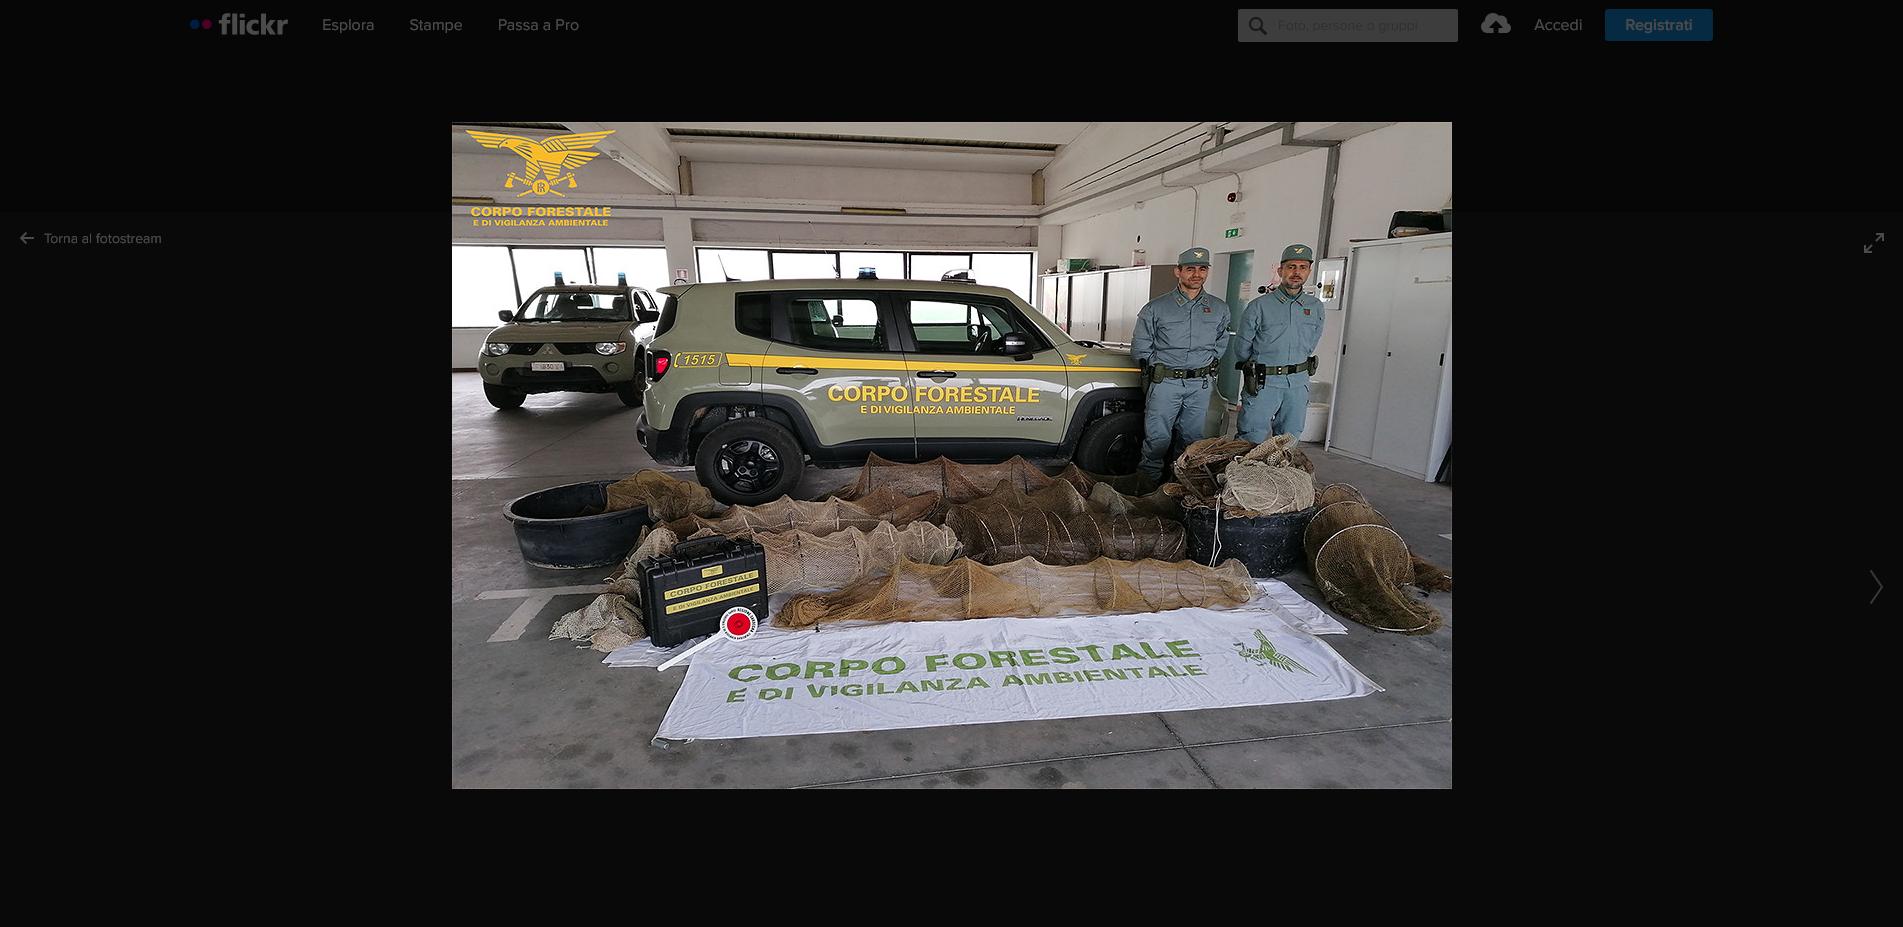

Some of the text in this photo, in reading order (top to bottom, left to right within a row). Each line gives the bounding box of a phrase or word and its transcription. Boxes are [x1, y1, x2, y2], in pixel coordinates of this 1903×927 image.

[219, 12, 288, 36] flickr
[322, 18, 374, 34] Esplora
[409, 18, 463, 34] Stampe
[498, 18, 579, 31] Passa a Pro
[1534, 18, 1582, 31] Accedi
[1626, 18, 1693, 34] Registrati
[44, 232, 162, 244] Torna al fotostream
[684, 354, 715, 365] 1515
[828, 385, 1040, 403] CORPO FORESTALE
[860, 405, 1015, 415] E DI VIGILANZA AMBIENTALE
[670, 572, 754, 597] CORPO FORESTALE
[687, 596, 718, 608] VIGILANZA
[719, 586, 754, 601] AMBIENTALE
[728, 640, 1203, 682] CORPO FORESTALE
[726, 664, 1207, 703] E DI VIGILANZA AMBIENTALE
